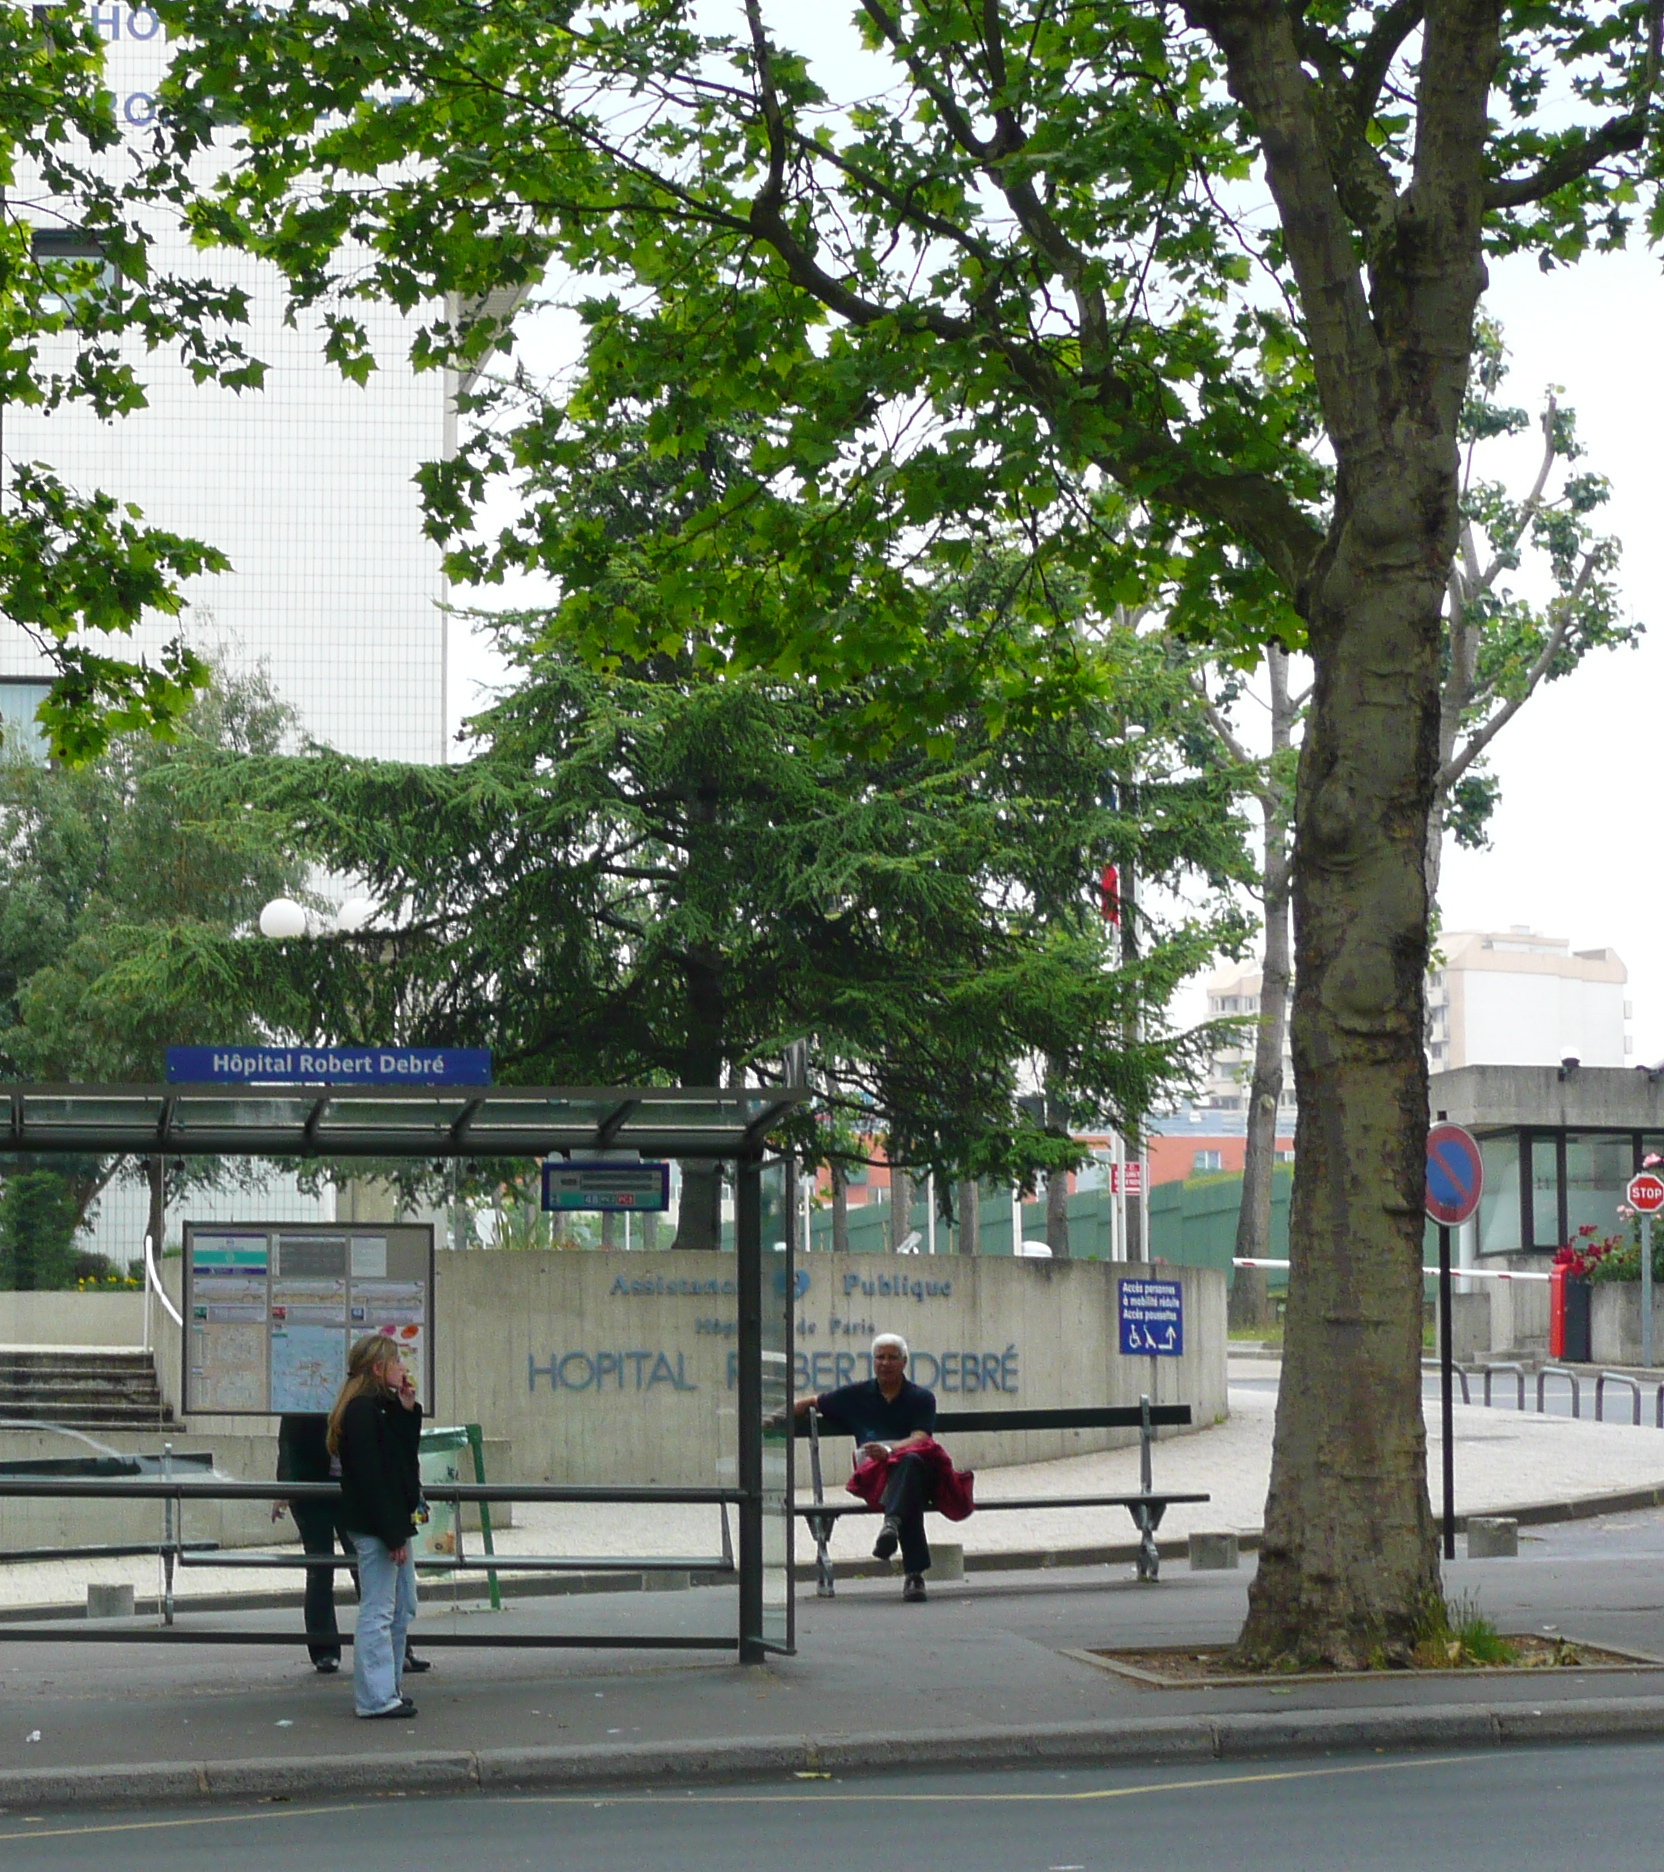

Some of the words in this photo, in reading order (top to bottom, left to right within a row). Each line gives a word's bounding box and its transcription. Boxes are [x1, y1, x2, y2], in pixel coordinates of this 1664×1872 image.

[213, 1053, 292, 1076] Hôpital
[299, 1054, 372, 1073] Robert
[379, 1054, 445, 1074] Debré
[1632, 1187, 1662, 1200] STOP
[609, 1273, 738, 1296] Assistanc
[843, 1272, 953, 1302] Publique
[796, 1317, 816, 1335] de
[829, 1318, 876, 1336] Paris
[527, 1350, 698, 1392] HOPITAL
[726, 1350, 875, 1392] RBERT
[910, 1343, 1020, 1392] DEBRÉ
